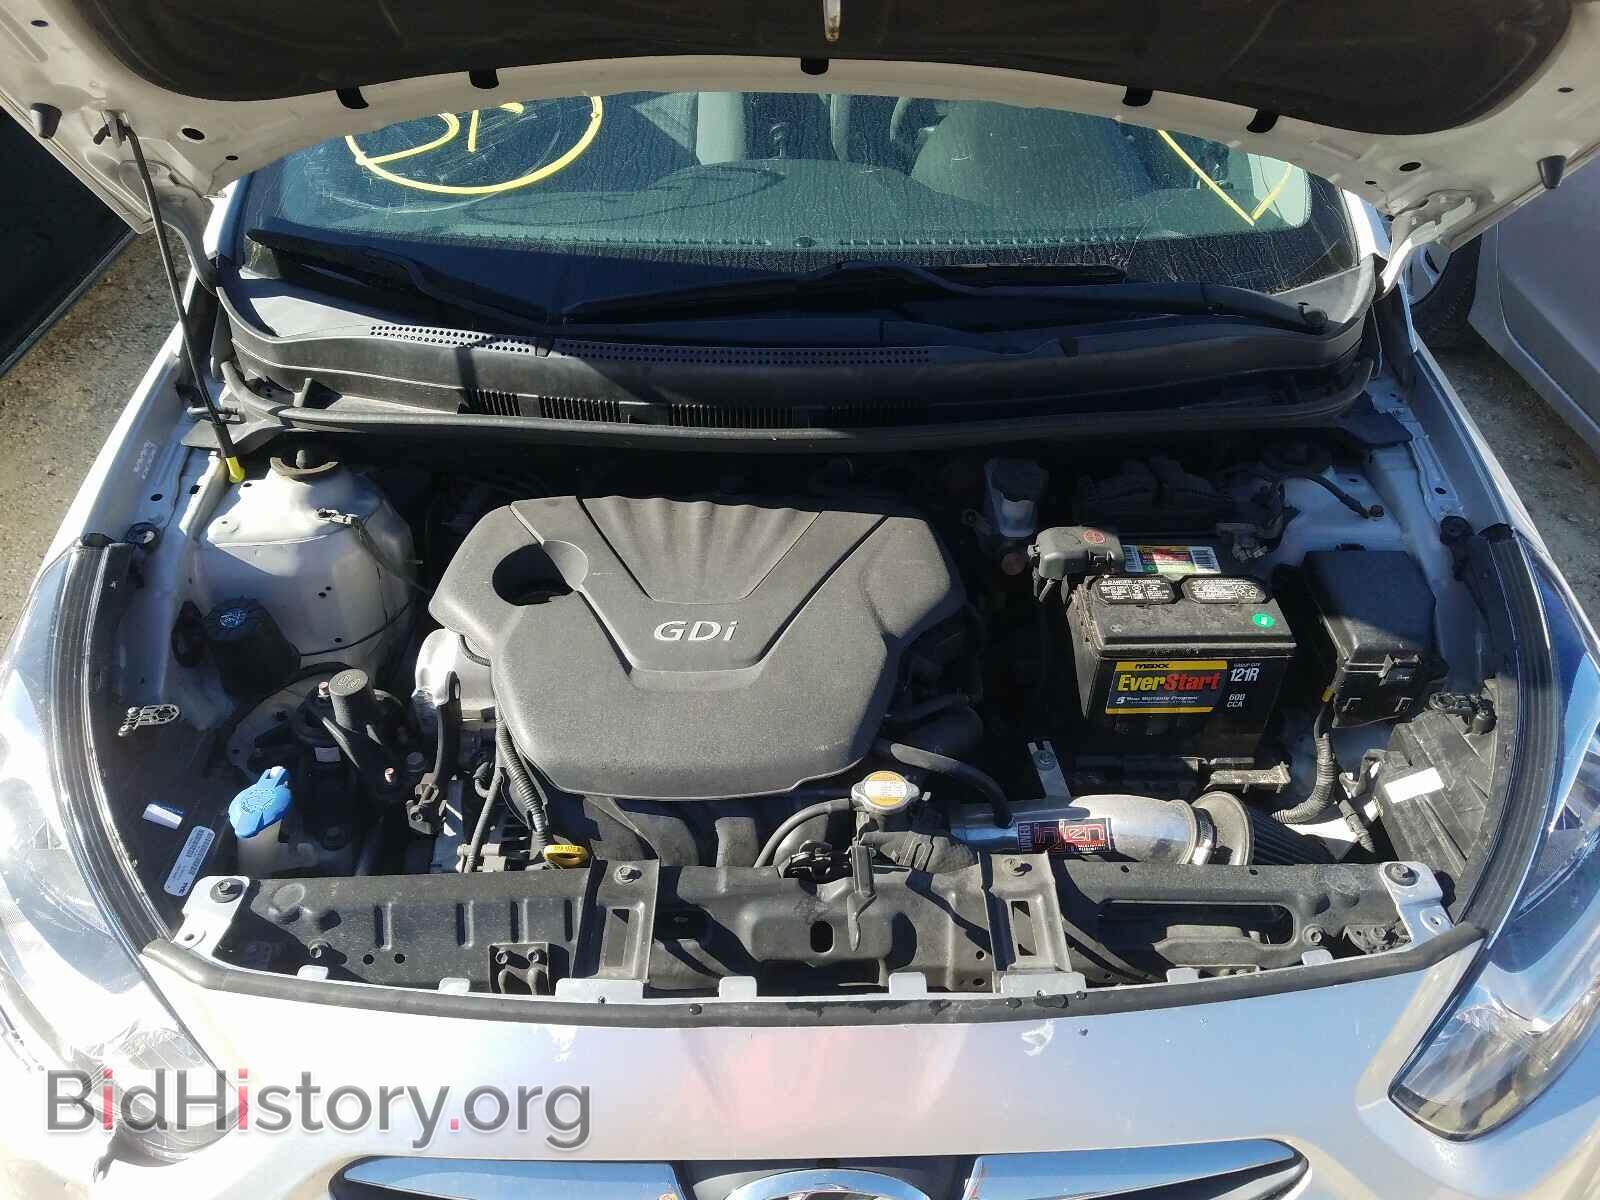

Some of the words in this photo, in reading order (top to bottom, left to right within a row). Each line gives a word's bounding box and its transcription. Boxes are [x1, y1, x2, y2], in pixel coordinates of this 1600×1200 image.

[653, 620, 739, 641] GDi
[1117, 673, 1219, 692] EverStart
[1230, 667, 1260, 682] 121R
[1229, 693, 1246, 701] 600
